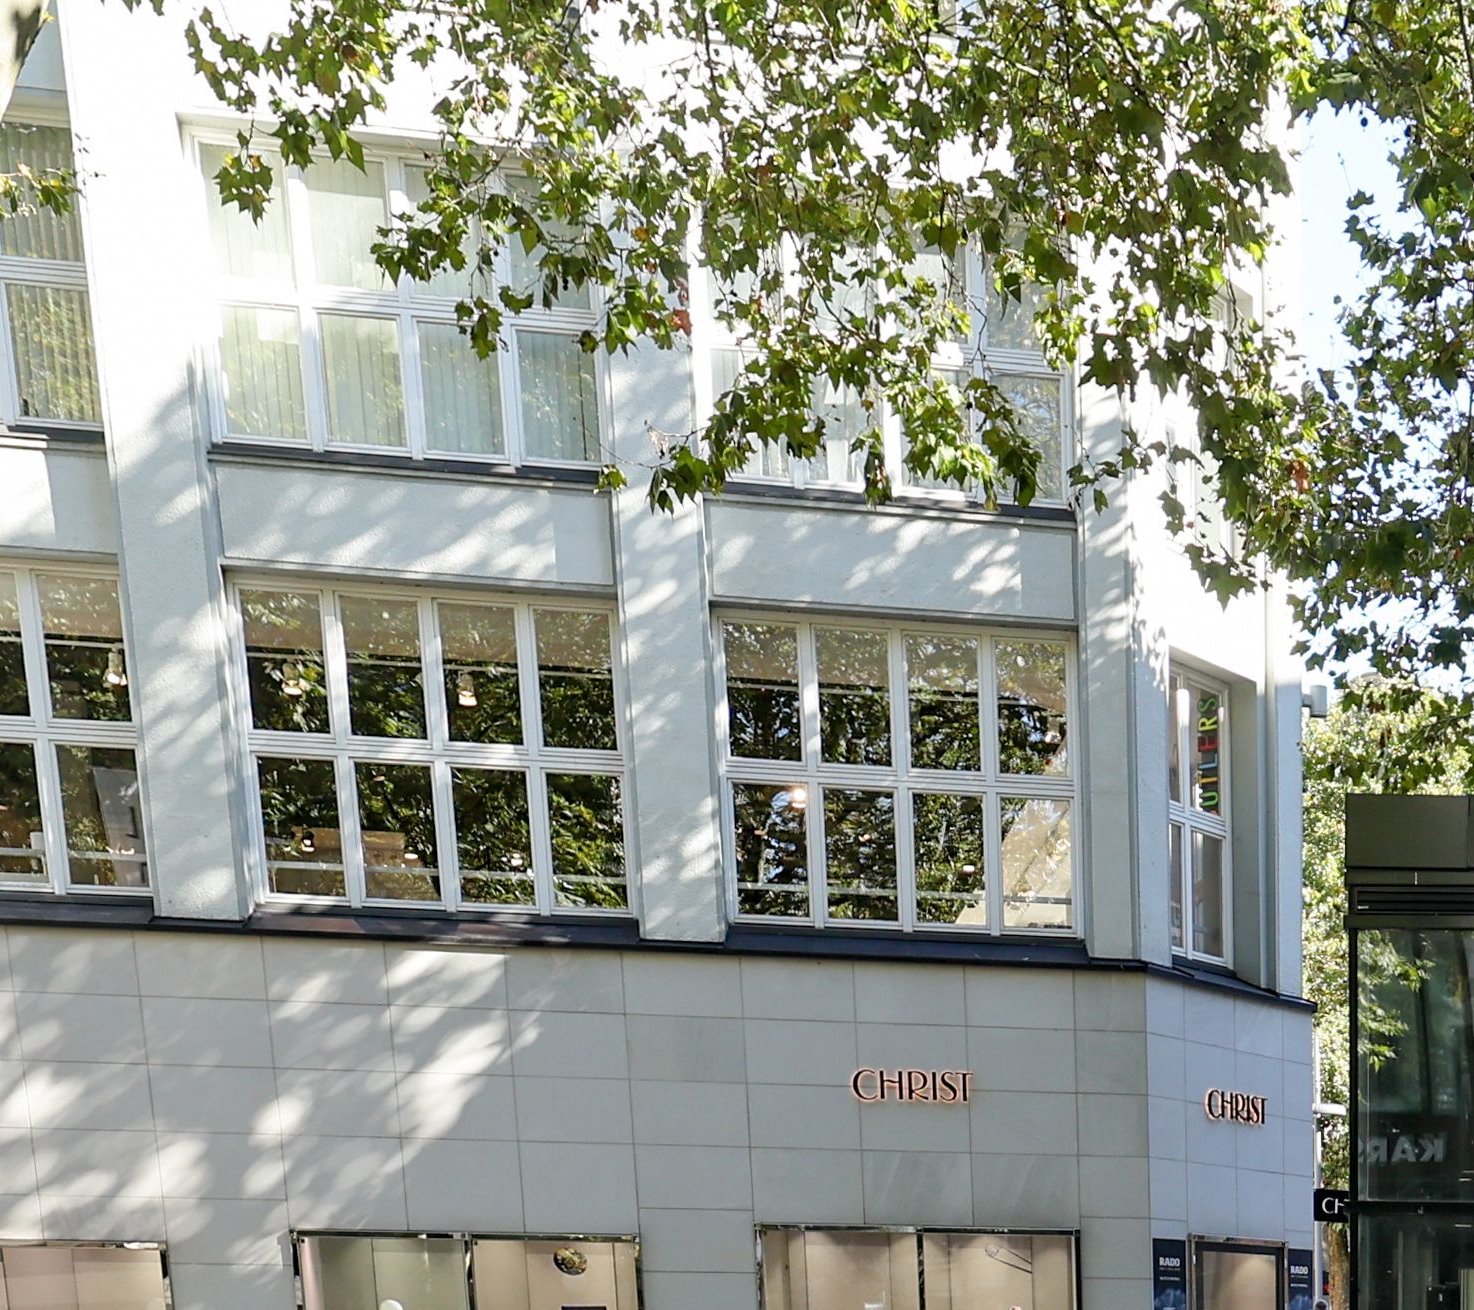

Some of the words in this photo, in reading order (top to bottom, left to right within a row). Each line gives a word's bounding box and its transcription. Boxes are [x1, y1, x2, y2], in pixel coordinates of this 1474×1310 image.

[1197, 696, 1220, 816] UTLERS
[851, 1068, 973, 1102] CHRIST
[1205, 1088, 1268, 1125] CHRIST
[1159, 1257, 1181, 1267] RADO
[1290, 1265, 1309, 1275] RADO
